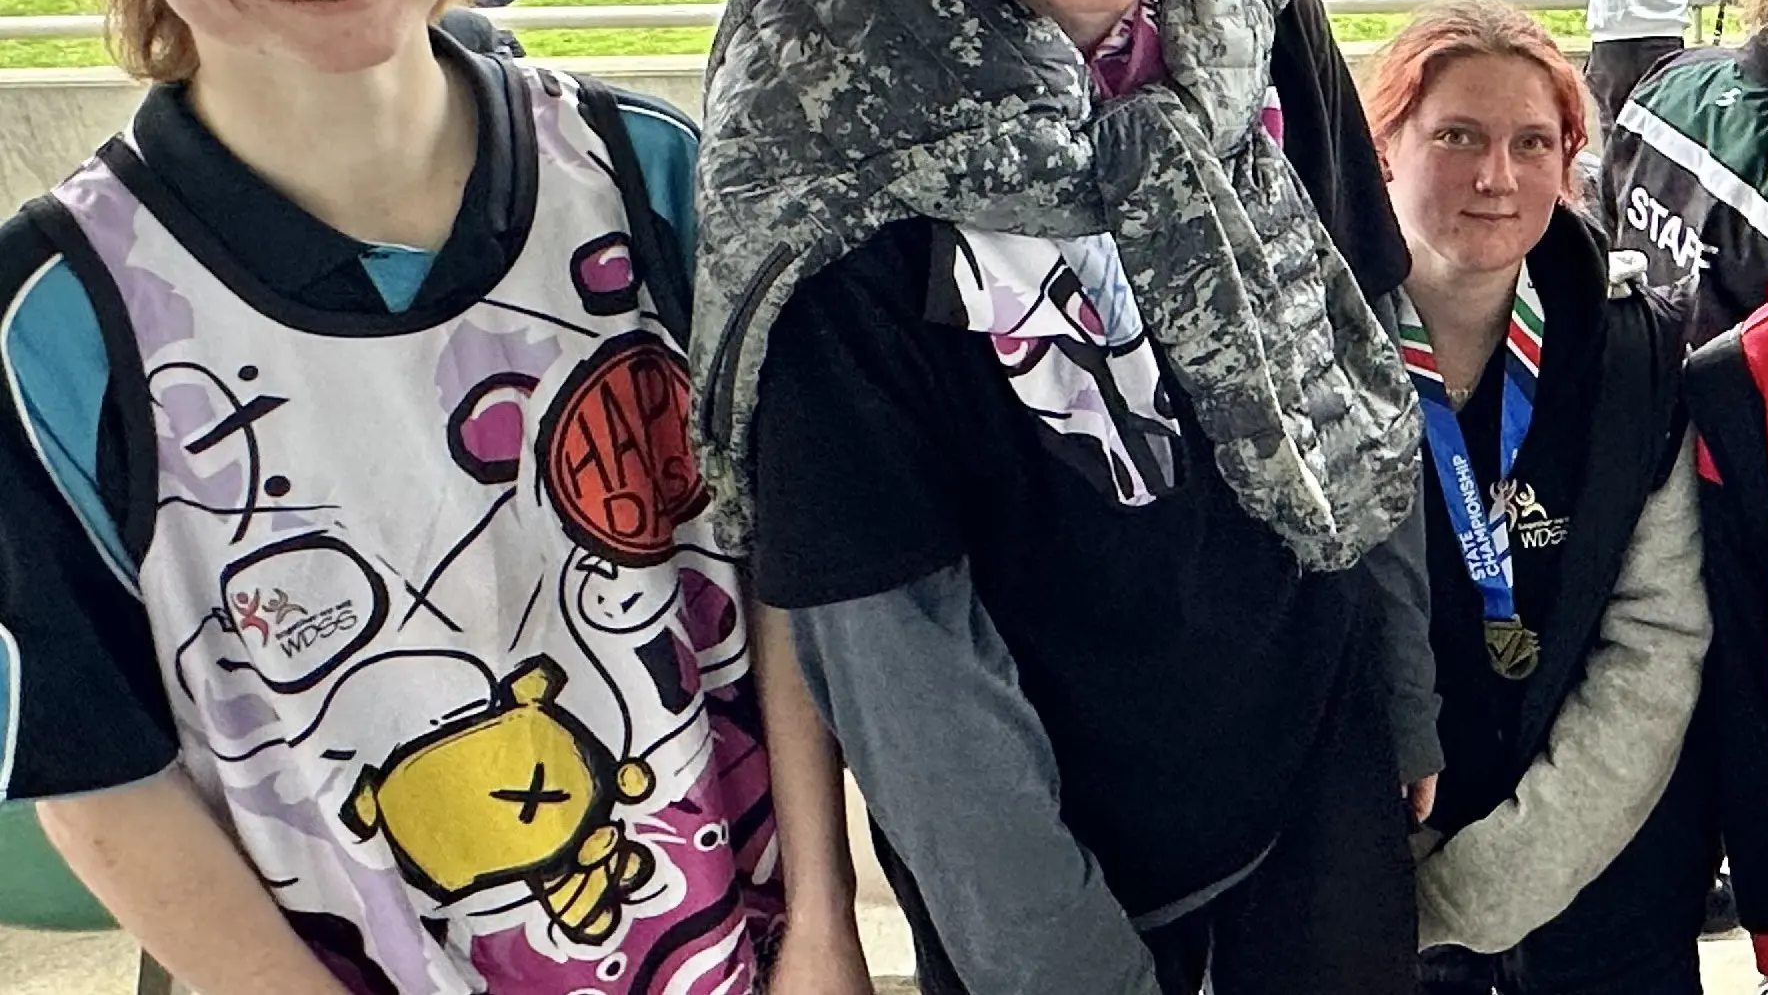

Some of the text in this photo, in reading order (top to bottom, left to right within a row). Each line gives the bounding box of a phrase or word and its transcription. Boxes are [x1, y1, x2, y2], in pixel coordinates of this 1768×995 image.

[1452, 454, 1500, 577] CHAMPIONSHIP
[1460, 530, 1486, 581] STATE
[279, 609, 357, 659] WDSS
